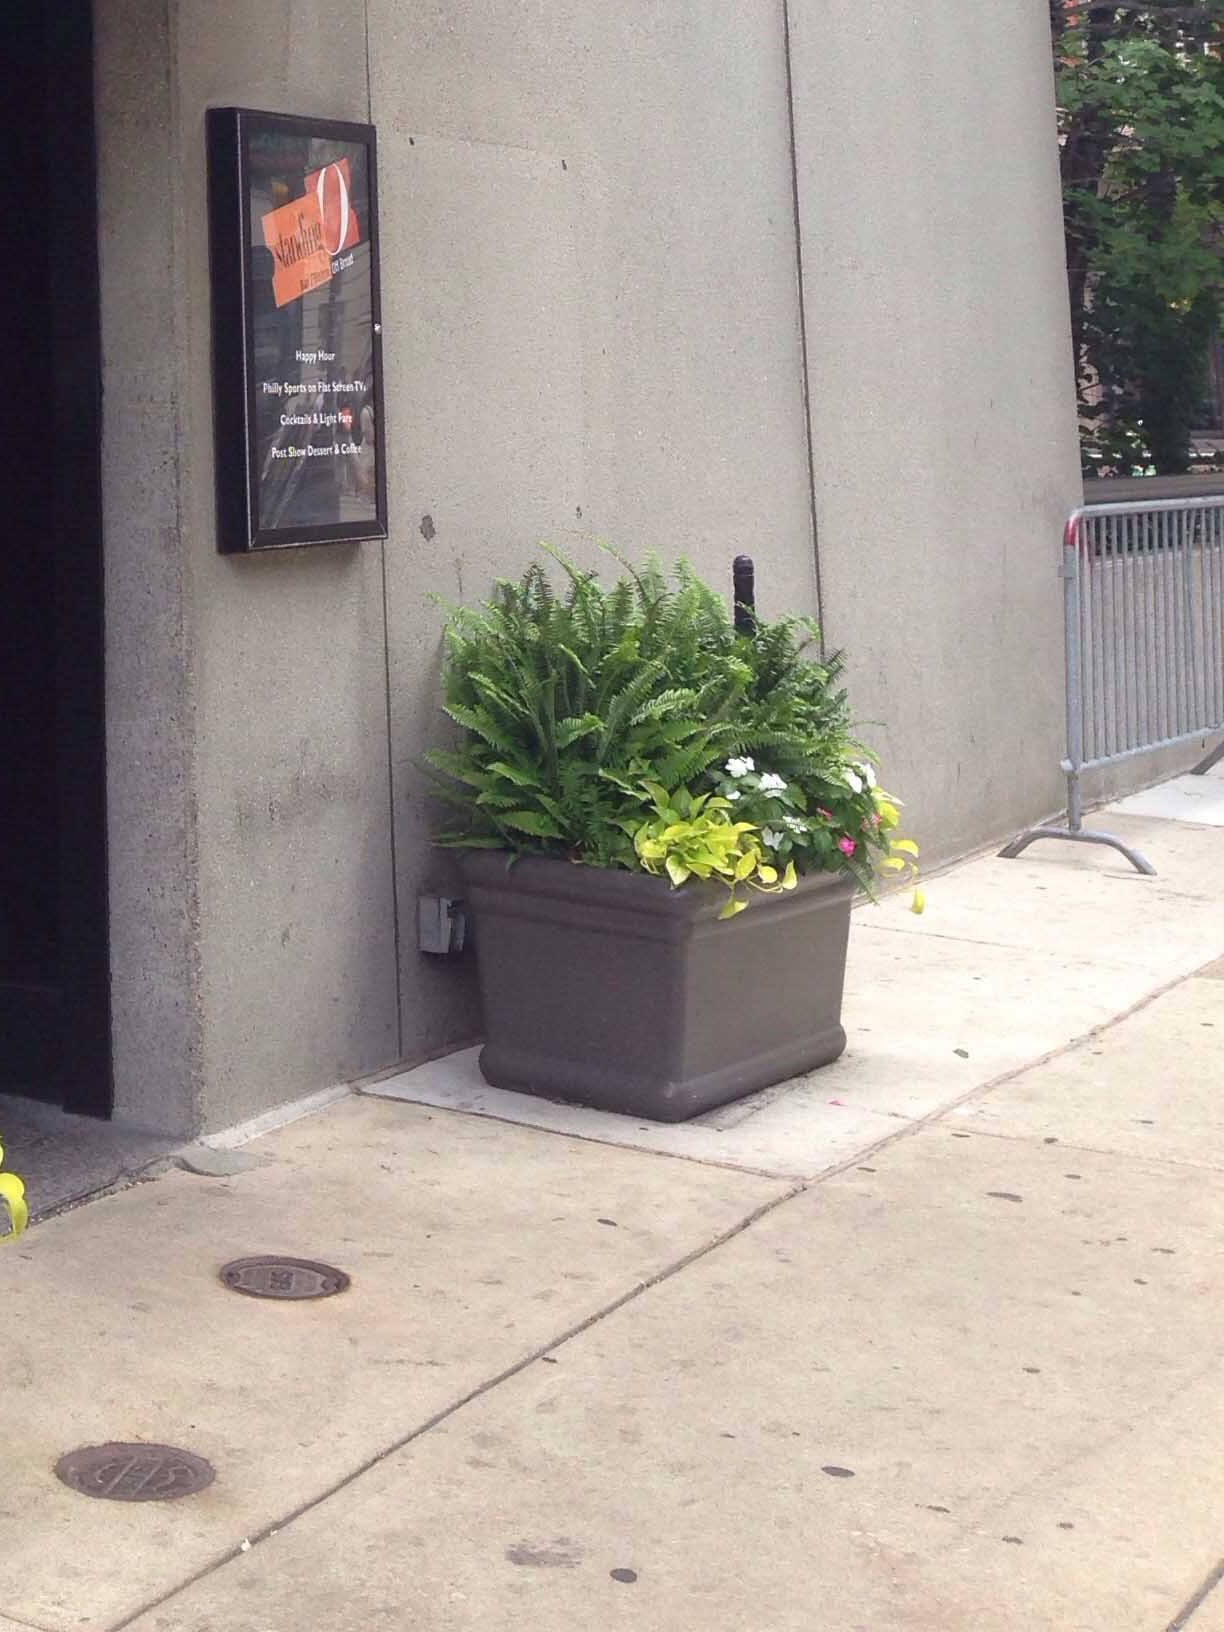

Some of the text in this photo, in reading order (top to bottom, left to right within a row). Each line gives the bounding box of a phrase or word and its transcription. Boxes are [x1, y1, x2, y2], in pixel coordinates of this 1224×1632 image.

[316, 163, 349, 256] O
[296, 350, 336, 364] Happy Hour
[263, 382, 283, 397] Philly
[284, 381, 308, 396] Sports
[308, 384, 317, 392] on
[318, 381, 332, 392] Flat
[333, 380, 354, 391] Screen
[280, 412, 353, 427] Cocktails & Light Fare
[272, 443, 362, 458] Post Show Dessert & Coffee
